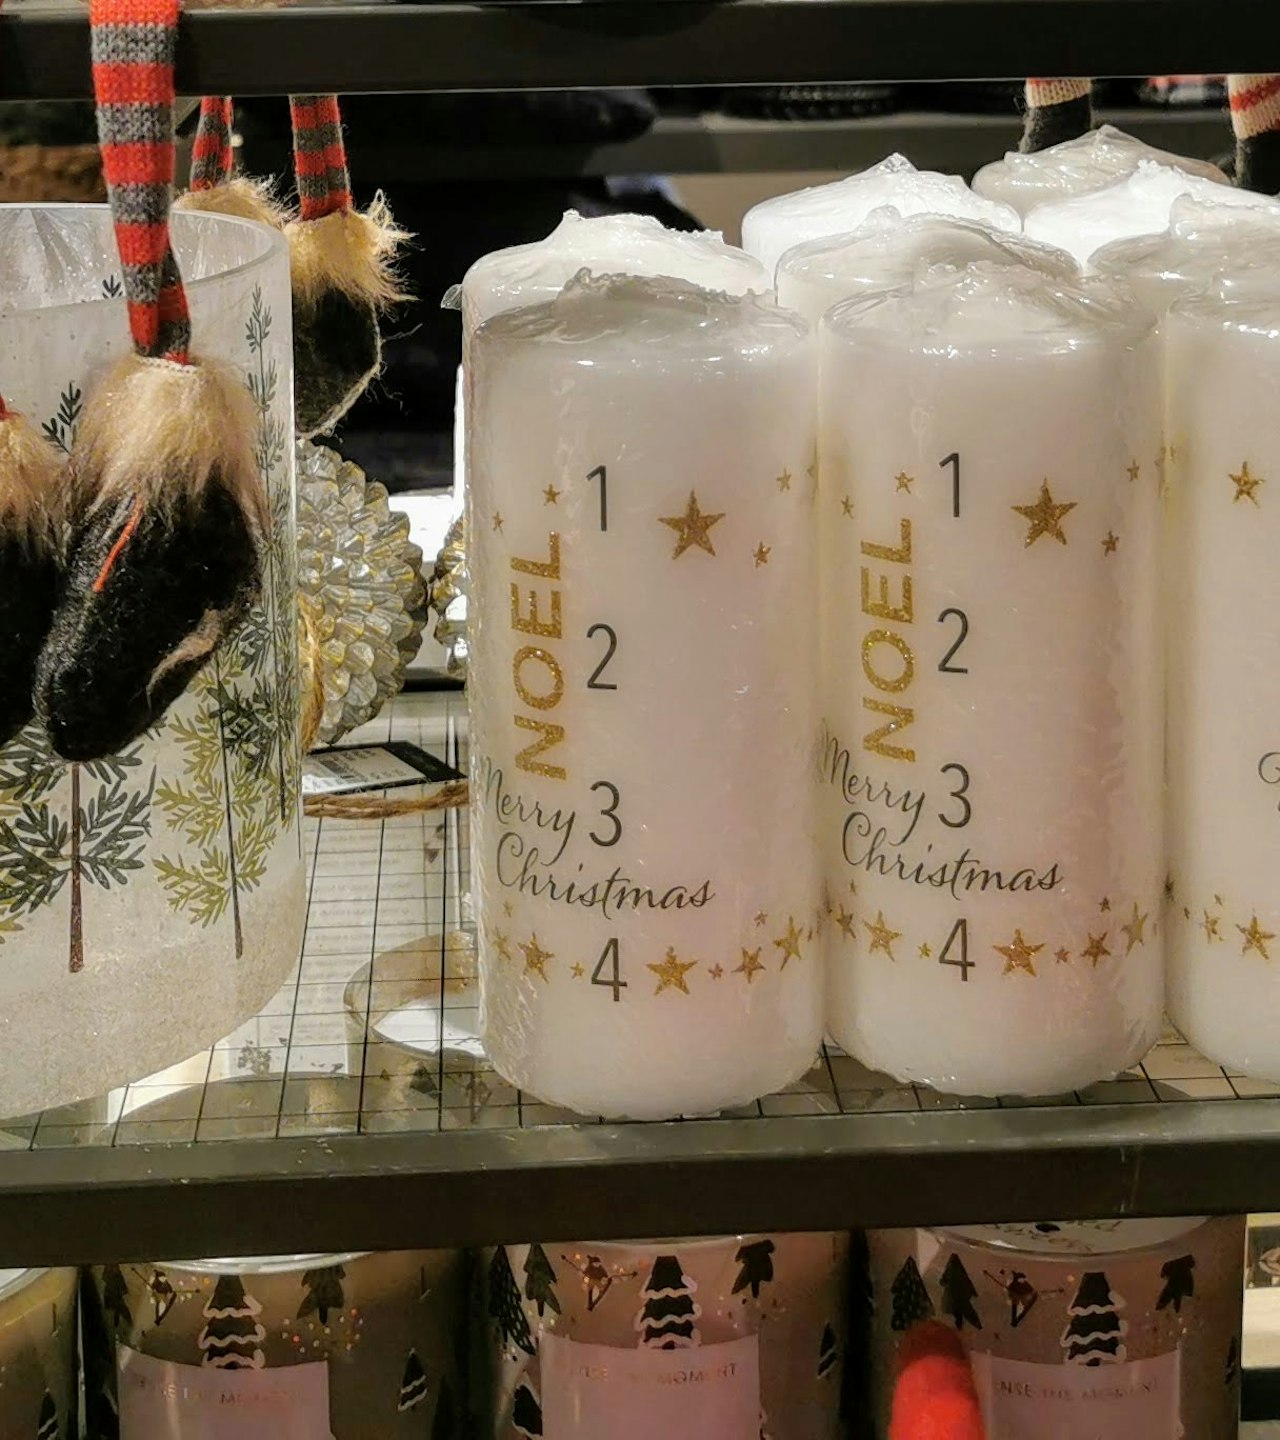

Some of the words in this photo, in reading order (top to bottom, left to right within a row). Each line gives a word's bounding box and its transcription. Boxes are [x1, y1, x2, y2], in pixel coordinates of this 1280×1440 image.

[586, 465, 608, 532] 1
[938, 453, 960, 518] 1
[509, 530, 567, 781] NOEL
[586, 623, 618, 690] 2
[860, 517, 917, 763] NOEL
[938, 608, 969, 674] 2
[483, 756, 576, 866] Merry
[589, 780, 622, 847] 3
[821, 718, 926, 846] Merry
[938, 763, 971, 828] 3
[496, 831, 716, 920] Christmas
[842, 811, 1064, 901] Christmas
[591, 938, 627, 1002] 4
[938, 918, 976, 982] 4
